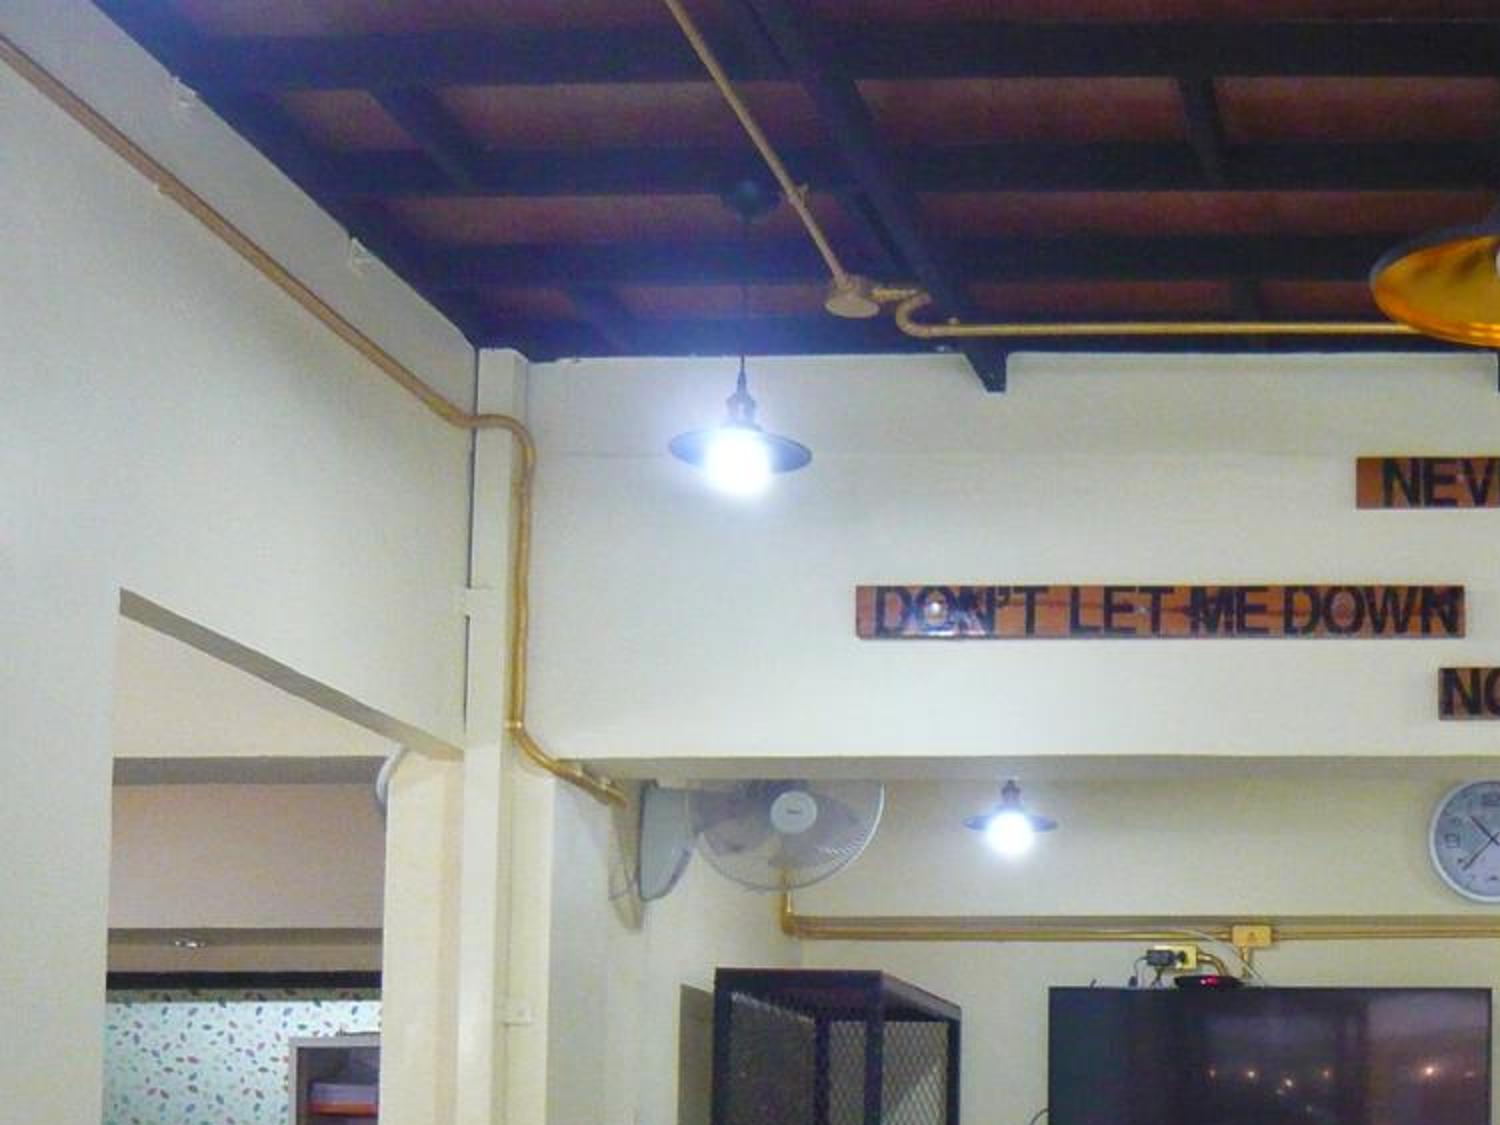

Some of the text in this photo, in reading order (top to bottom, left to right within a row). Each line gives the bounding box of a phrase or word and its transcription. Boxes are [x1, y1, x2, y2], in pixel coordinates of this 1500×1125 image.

[874, 585, 1462, 637] DON'T LET ME DOWN
